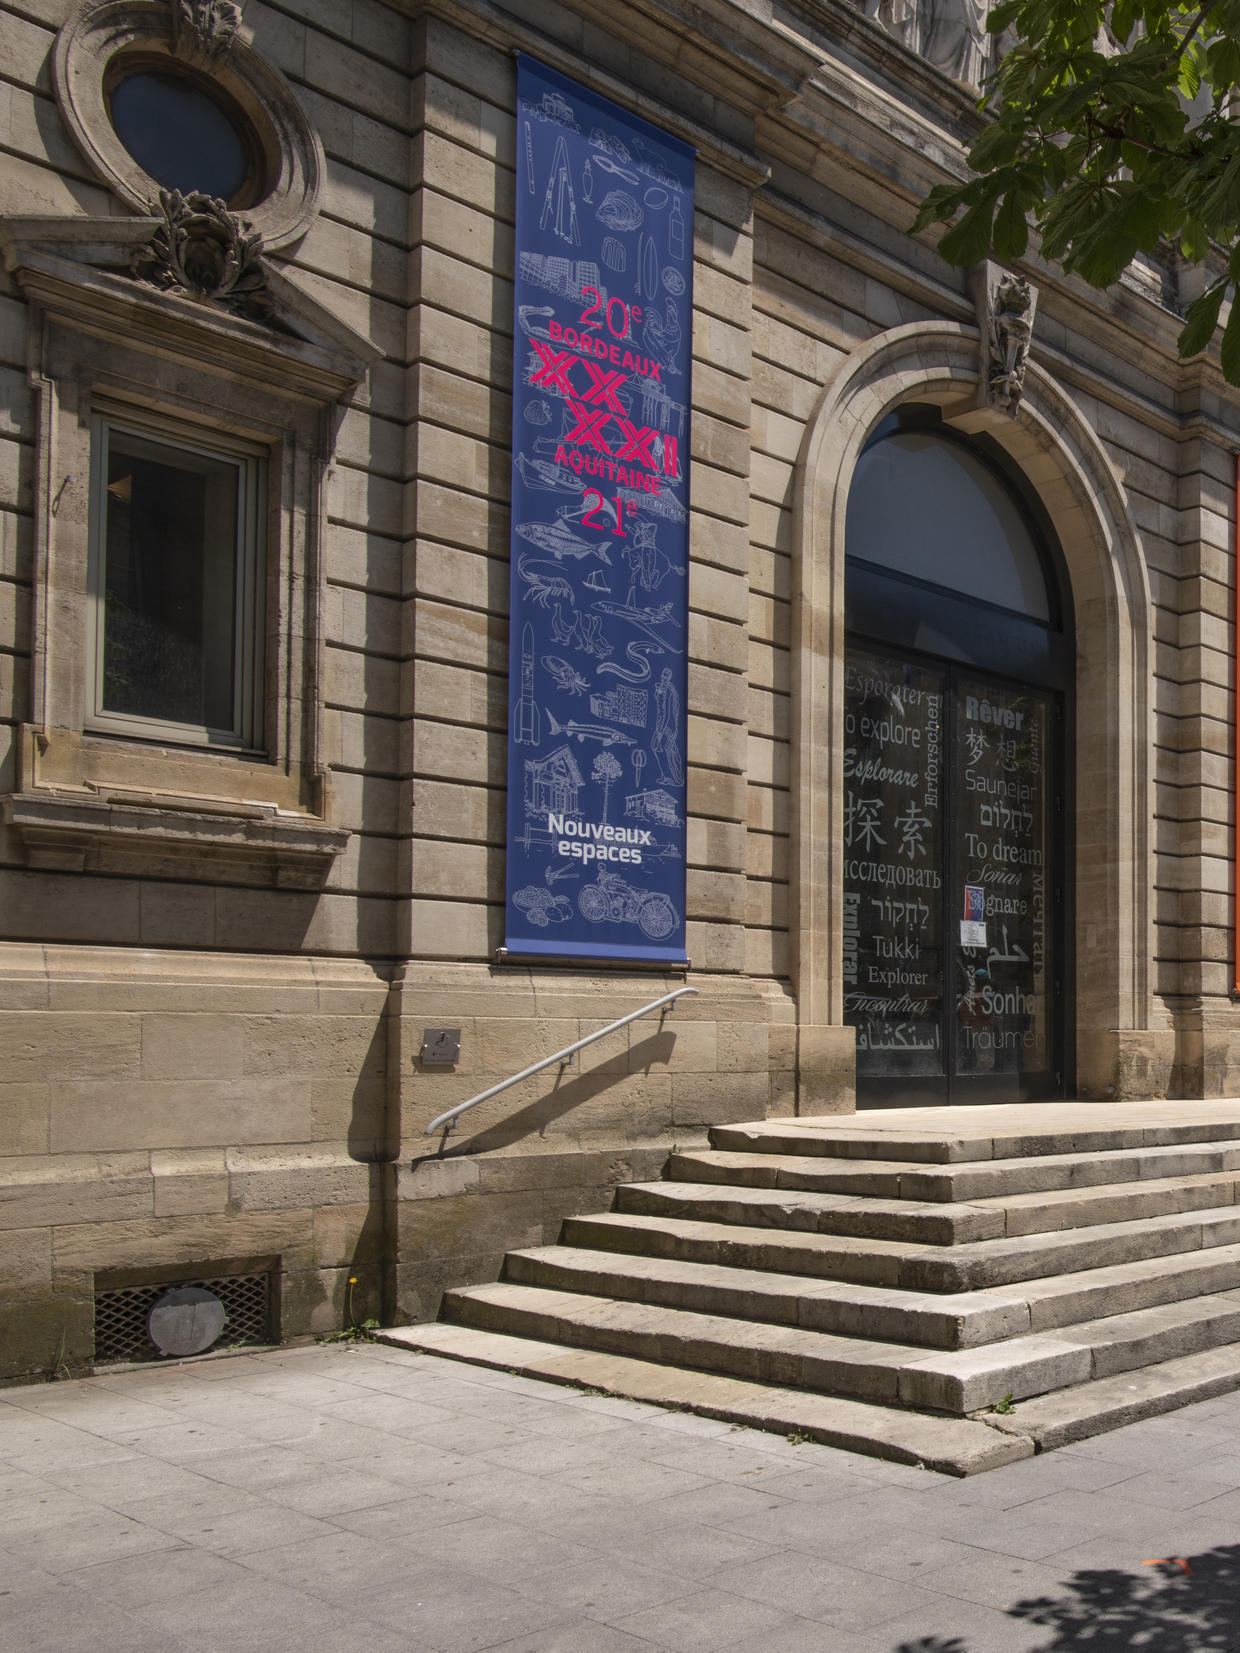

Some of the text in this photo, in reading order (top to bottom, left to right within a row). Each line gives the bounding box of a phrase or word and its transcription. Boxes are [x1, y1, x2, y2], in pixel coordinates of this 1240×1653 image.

[549, 320, 661, 392] BORDEAUX
[554, 445, 662, 496] AQUITAINE
[966, 695, 1024, 731] Rêver
[860, 715, 921, 750] explore
[843, 748, 919, 788] Esplorare
[924, 695, 938, 808] Erforschen
[548, 813, 652, 846] Nouveaux
[844, 790, 933, 860] 探索
[558, 840, 642, 865] espaces
[965, 833, 1042, 865] To dream
[872, 935, 919, 959] Tukki
[868, 966, 928, 988] Explorer
